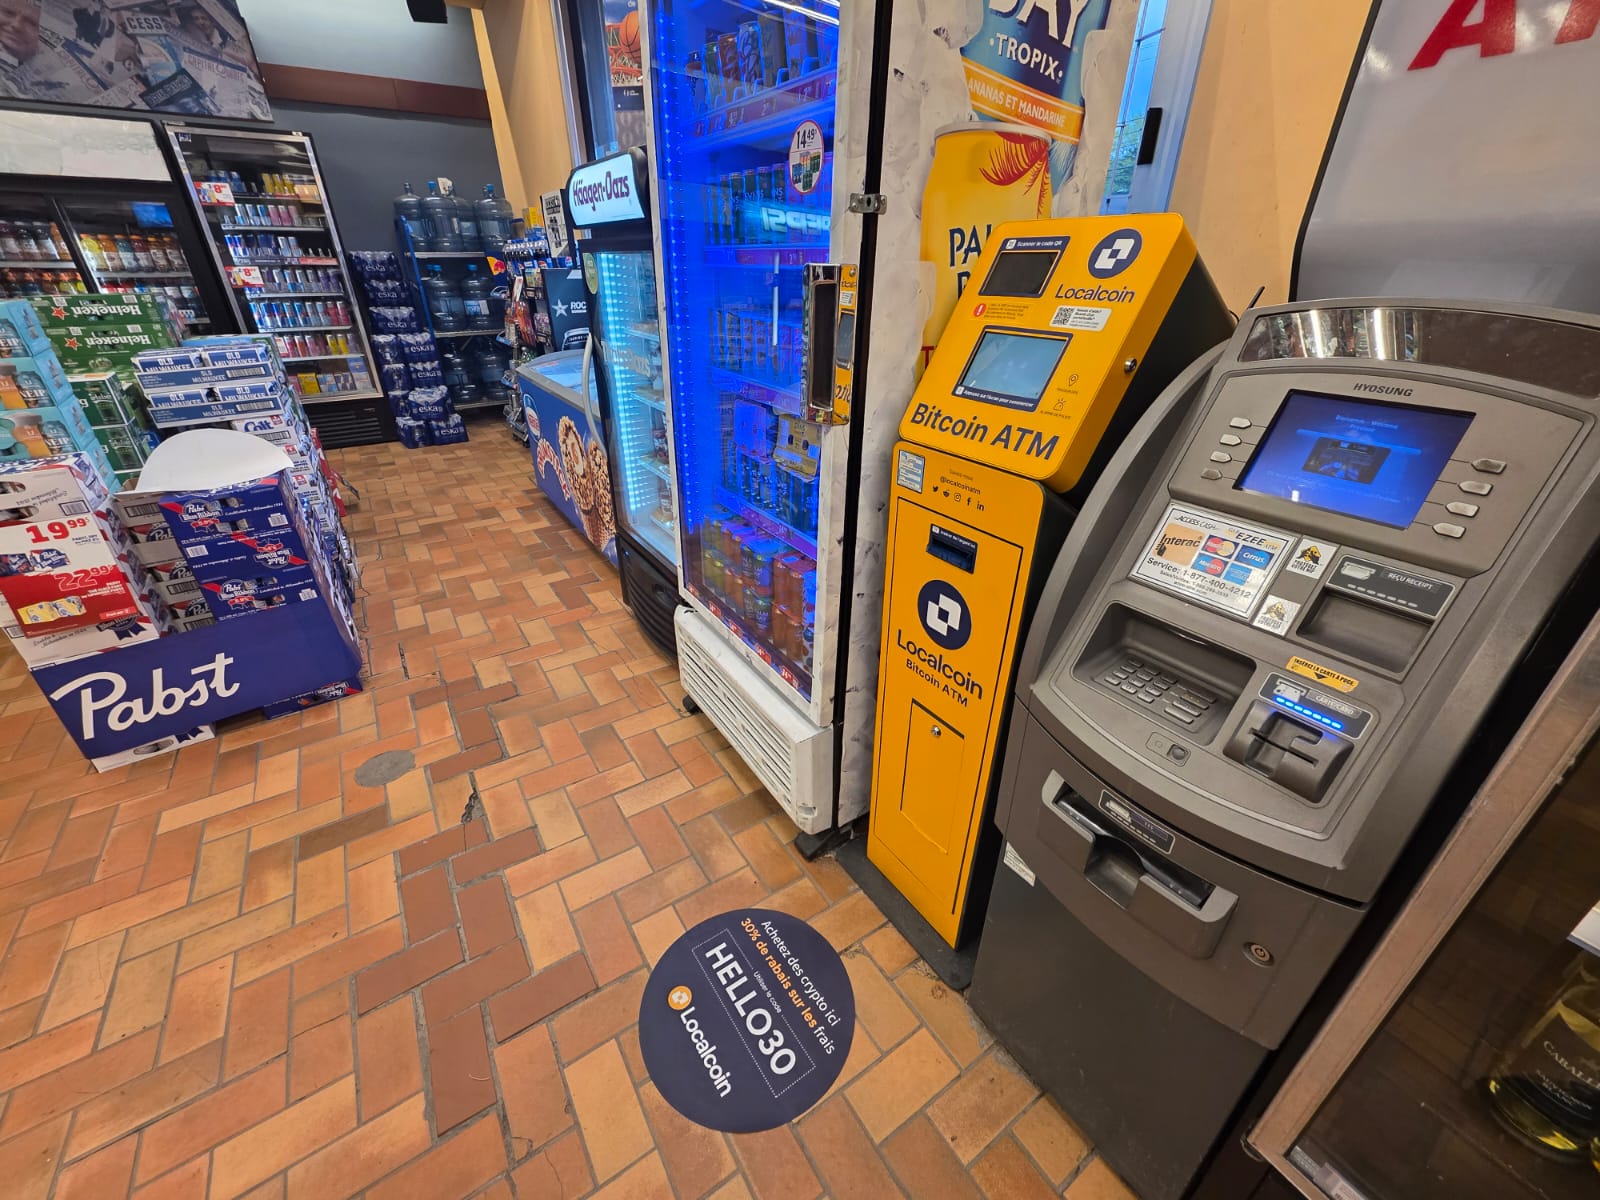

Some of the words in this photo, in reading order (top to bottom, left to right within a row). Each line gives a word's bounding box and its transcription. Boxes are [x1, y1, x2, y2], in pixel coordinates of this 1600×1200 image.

[990, 0, 1087, 48] AY
[995, 32, 1060, 80] TROPIX
[968, 78, 1004, 105] ANANAS
[1005, 94, 1018, 110] ET
[1018, 101, 1066, 128] MANDARINE
[71, 303, 143, 317] Heineken
[1055, 283, 1136, 303] Localcoin
[86, 333, 152, 348] Heineken
[157, 357, 175, 366] OLD
[225, 351, 241, 359] OLD
[235, 386, 251, 394] OLD
[1353, 383, 1413, 397] HYOSUNG
[910, 402, 989, 443] Bitcoin
[990, 425, 1060, 460] ATM
[1160, 533, 1201, 548] Interac
[1236, 531, 1267, 547] EZEE
[1147, 557, 1181, 576] Service:
[1182, 569, 1252, 599] 1-877-400-4212
[1405, 576, 1434, 590] RECEIPT
[897, 628, 984, 700] Localcoin
[906, 658, 940, 689] Bitcoin
[942, 683, 968, 707] ATM
[50, 652, 241, 740] Pabst
[740, 917, 762, 942] 30%
[756, 940, 770, 956] de
[765, 954, 793, 990] rabais
[788, 988, 806, 1009] sur
[801, 1007, 818, 1028] les
[813, 1025, 836, 1055] frais
[753, 970, 769, 993] Utiliser
[770, 996, 782, 1014] code
[761, 920, 791, 958] Achetez
[787, 956, 804, 977] des
[800, 975, 828, 1012] crypto
[826, 1008, 841, 1027] ici
[705, 942, 796, 1075] HELLO30
[680, 1006, 733, 1098] Localcoin
